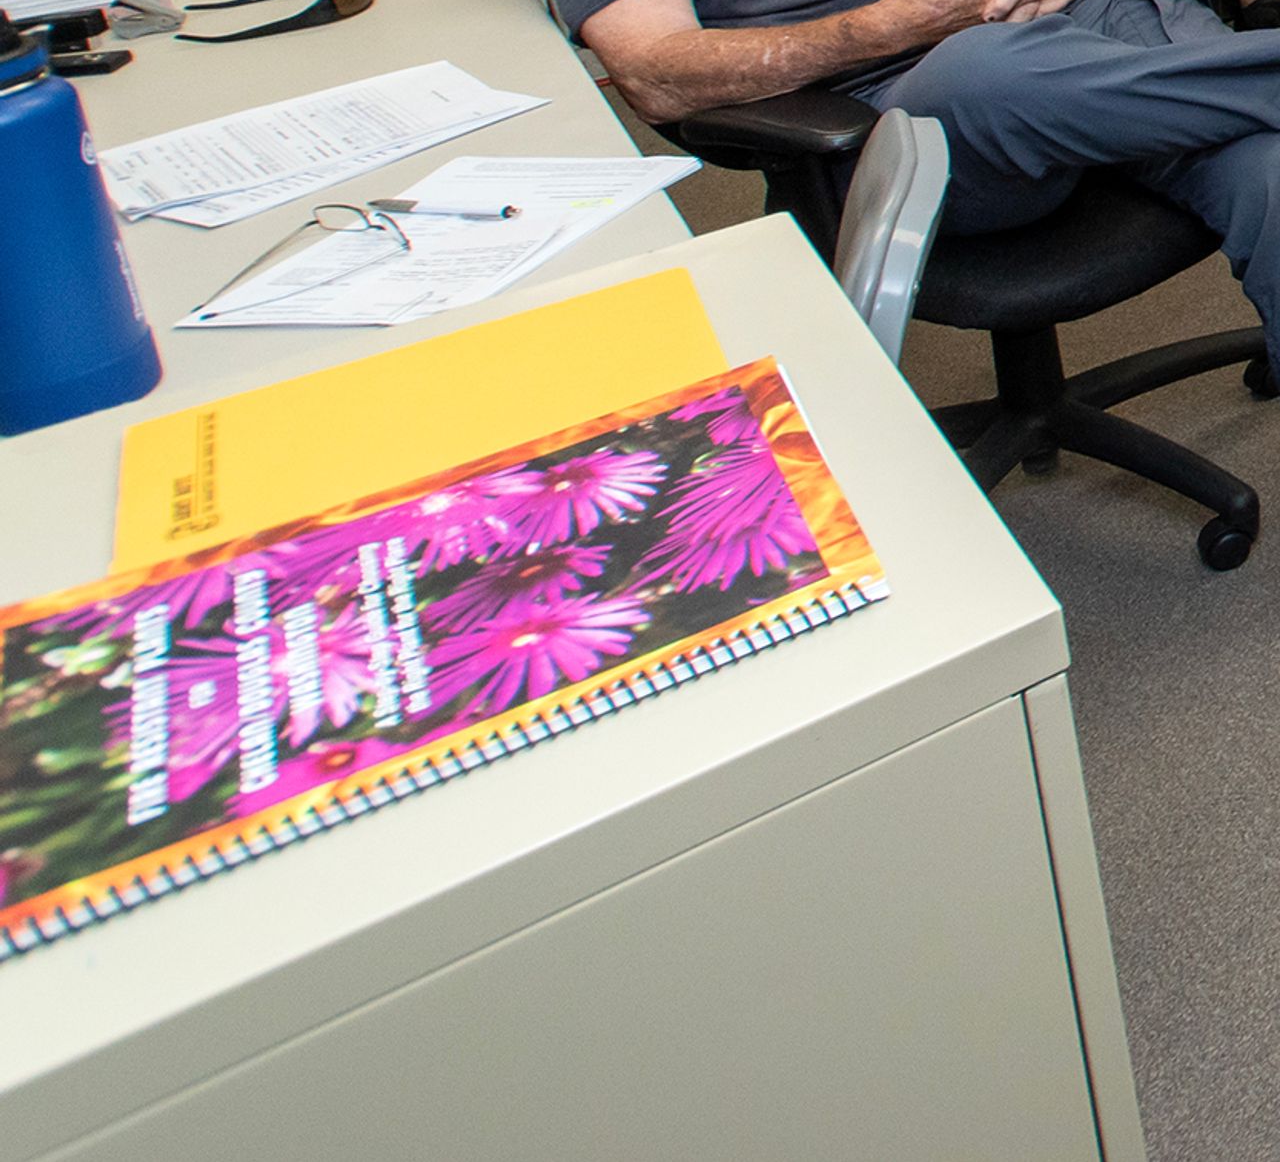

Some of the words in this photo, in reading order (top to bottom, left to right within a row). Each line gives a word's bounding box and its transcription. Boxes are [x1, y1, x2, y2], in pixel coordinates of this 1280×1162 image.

[132, 604, 170, 673] PLANTS
[232, 569, 270, 636] COUNTY
[283, 601, 323, 715] WASHINGTON
[129, 672, 170, 773] RESISTANT
